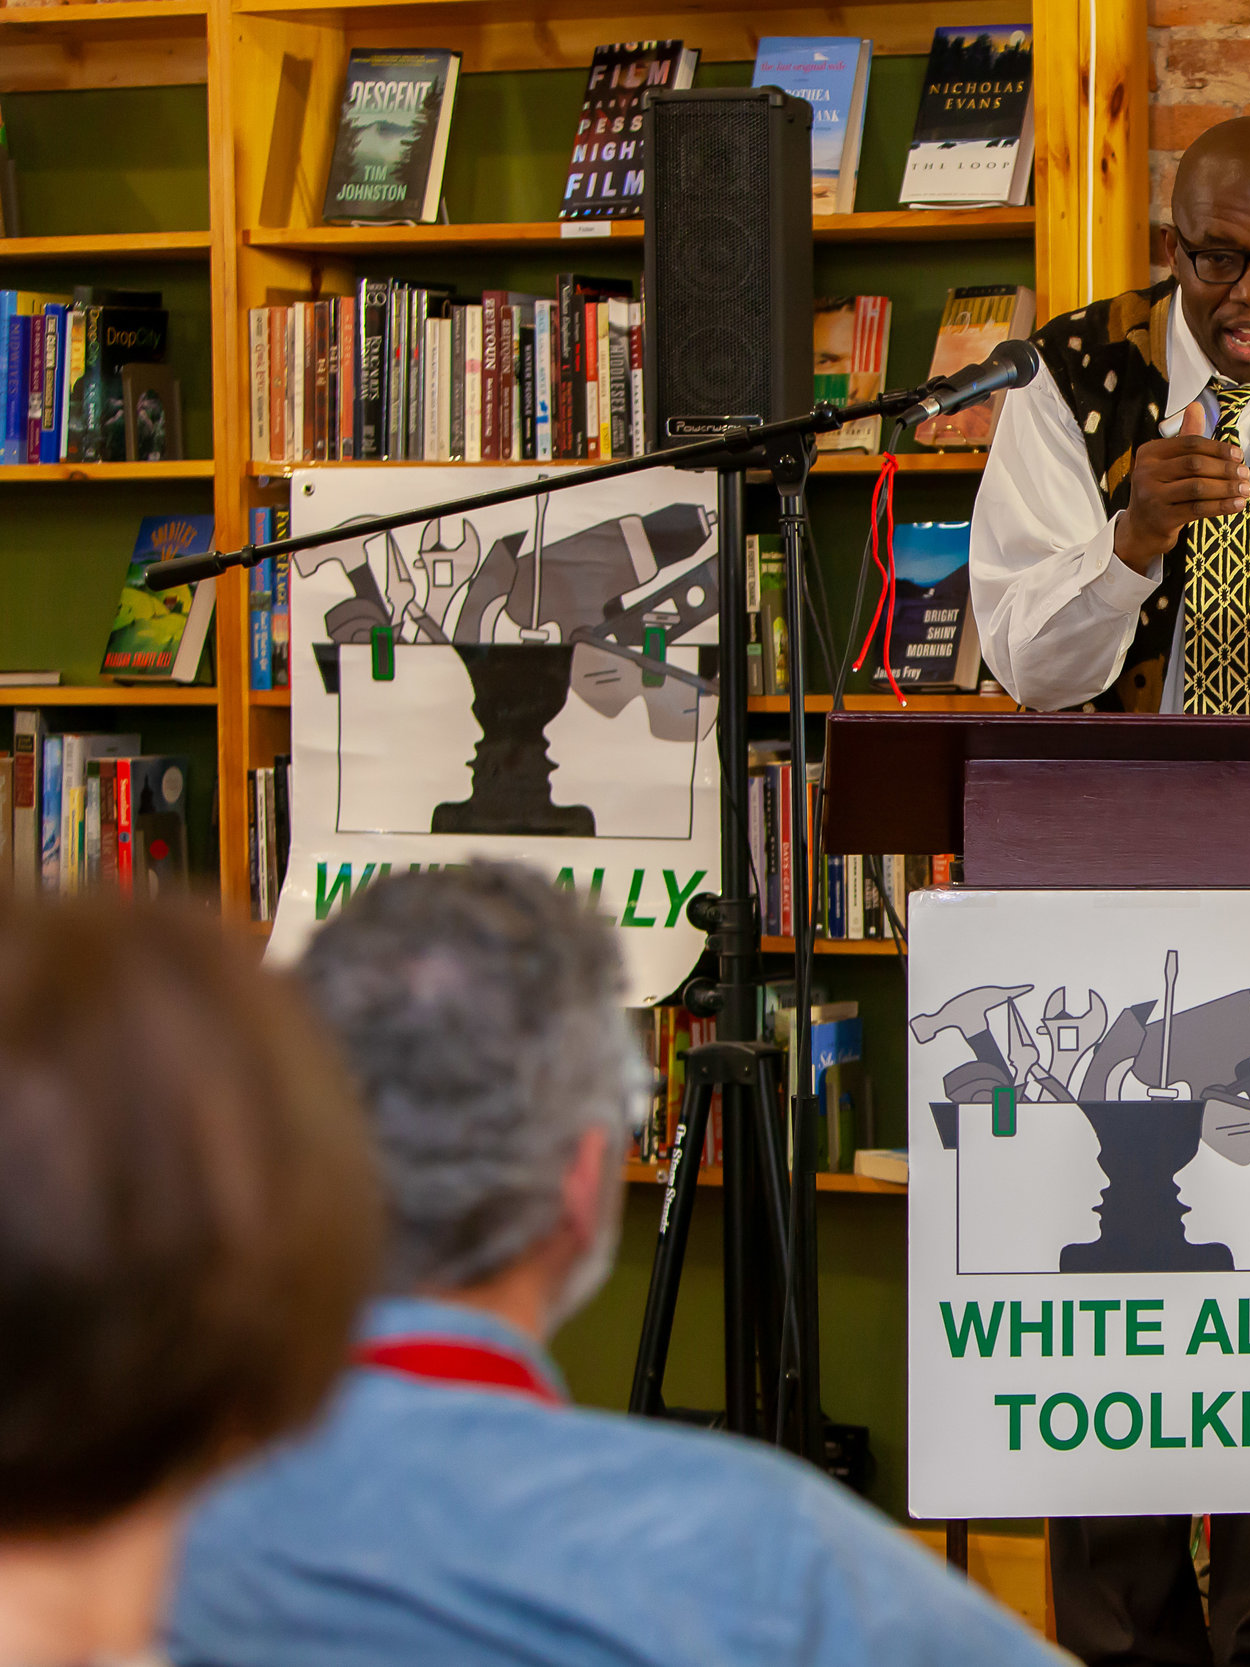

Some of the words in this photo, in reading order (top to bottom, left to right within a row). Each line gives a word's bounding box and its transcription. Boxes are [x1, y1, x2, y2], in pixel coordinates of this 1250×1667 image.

[589, 59, 671, 90] FILM
[350, 81, 432, 113] DESCENT
[929, 80, 1025, 95] NICHOLAS
[945, 97, 1002, 110] EVANS
[577, 115, 643, 135] PESS
[816, 109, 840, 122] ANK
[572, 140, 644, 164] NIGH
[363, 165, 388, 182] TIM
[958, 160, 1011, 170] LOOP
[337, 184, 407, 201] JOHNSTON
[564, 169, 645, 199] FILM
[107, 326, 161, 349] DropCity
[484, 298, 496, 370] ZEITOUN
[501, 319, 511, 374] ZEITOUN
[9, 323, 20, 394] MIDWIVES
[610, 344, 625, 413] MIDDLESEX
[924, 609, 960, 622] BRIGHT
[927, 626, 957, 640] SHINY
[906, 643, 953, 657] MORNING
[873, 666, 901, 679] Jaes
[902, 665, 922, 680] Frey
[782, 842, 790, 868] DAYS
[675, 1124, 687, 1145] On
[940, 1299, 1164, 1359] WHITE
